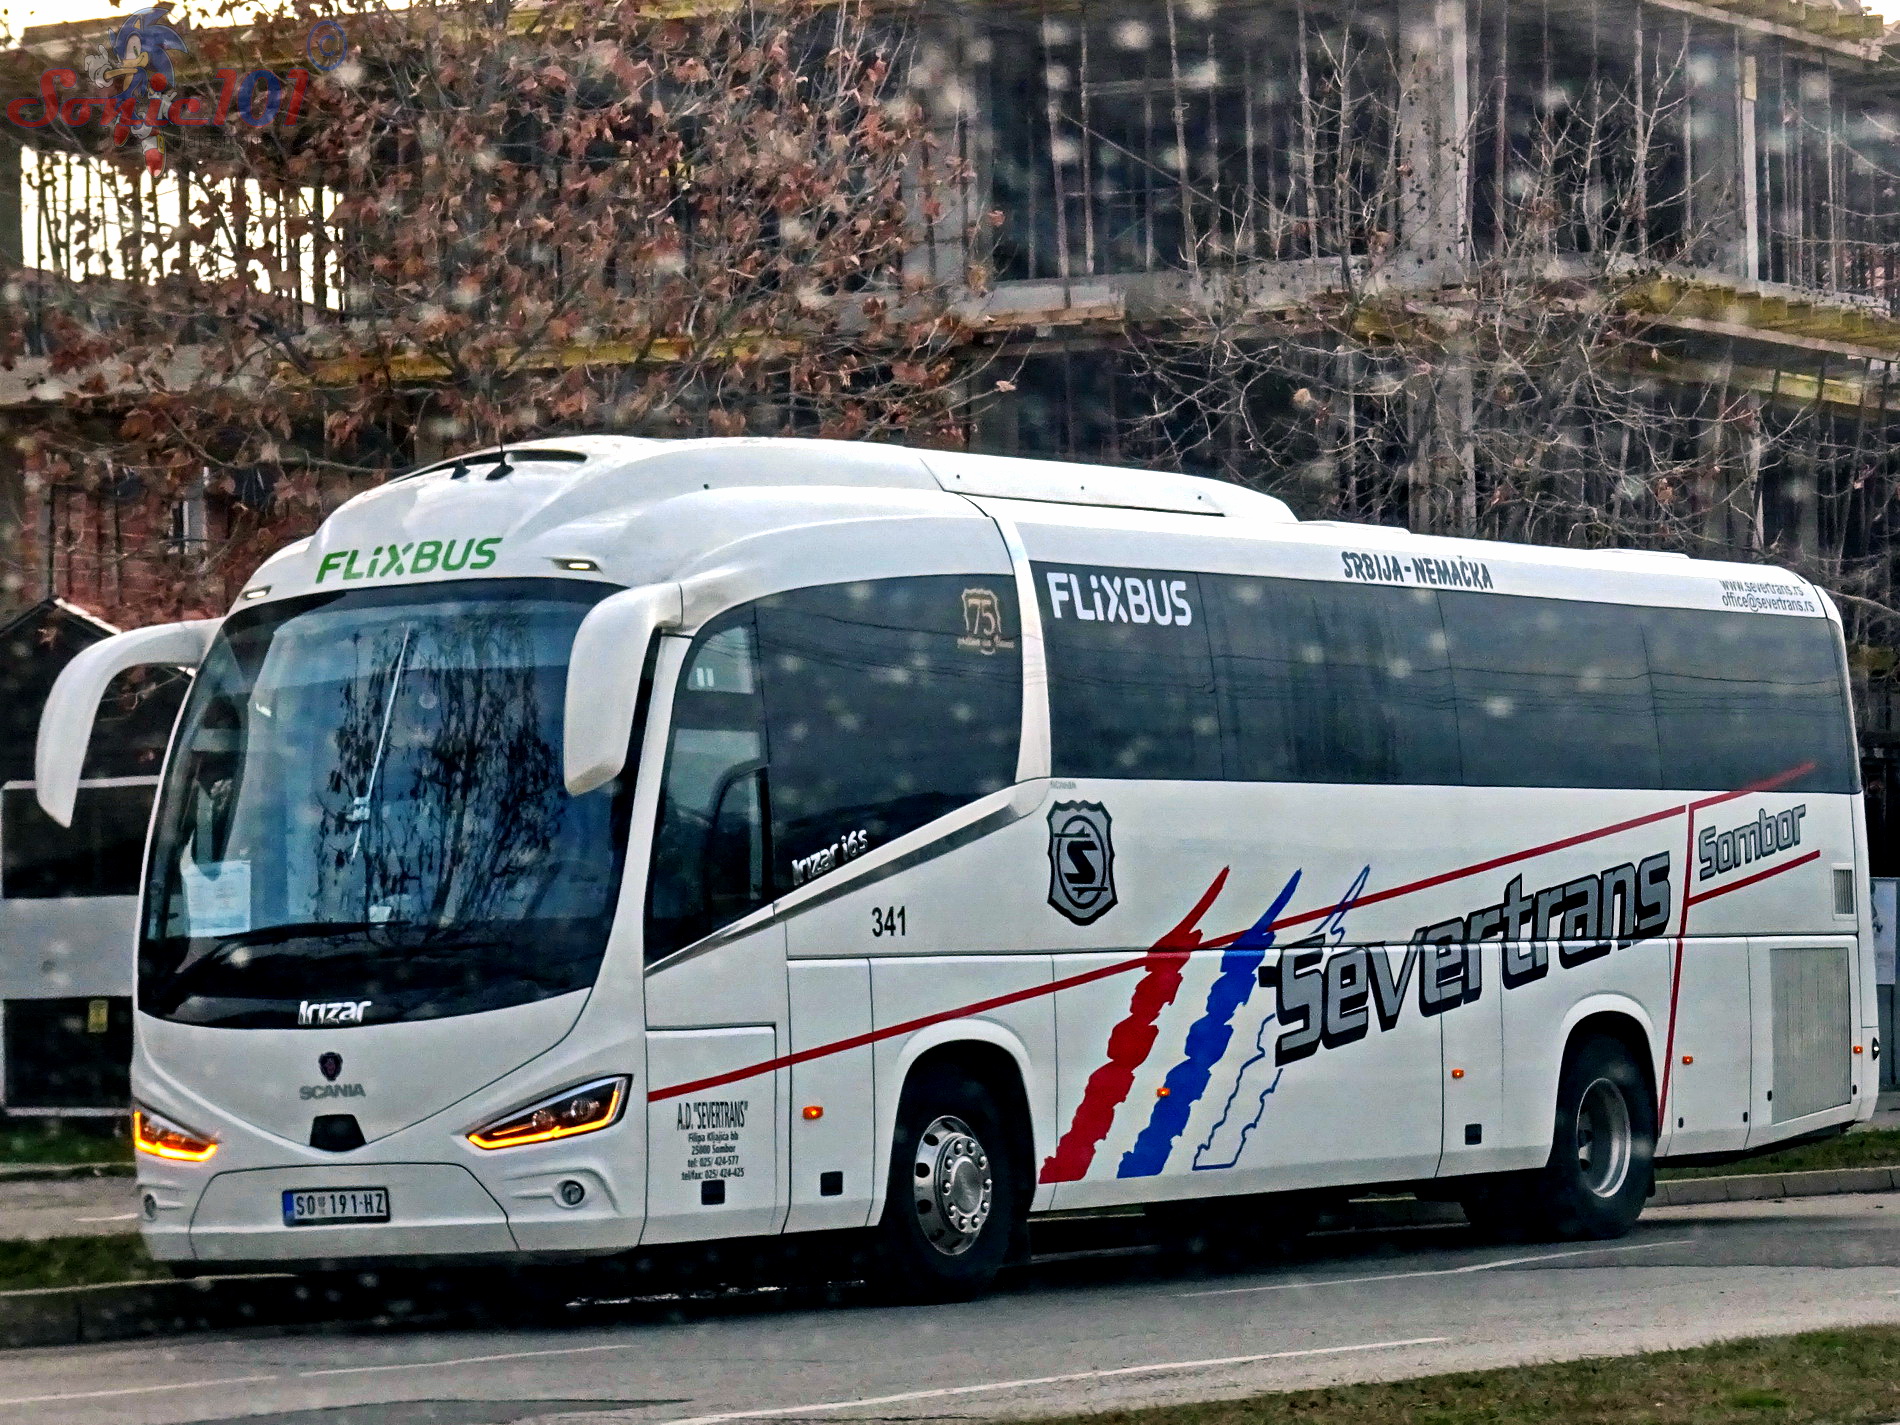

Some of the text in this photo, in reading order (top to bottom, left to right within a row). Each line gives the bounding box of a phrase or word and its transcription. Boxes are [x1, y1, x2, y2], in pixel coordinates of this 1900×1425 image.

[1720, 579, 1804, 597] www.severtrans.rs
[1721, 590, 1815, 612] office@severtrans.rs
[1698, 803, 1806, 882] Sombor
[791, 843, 839, 886] Irizar
[872, 905, 906, 937] 341
[1259, 850, 1671, 1067] Severtrans
[298, 1000, 372, 1026] Irizar
[299, 1083, 367, 1100] SCANIA
[712, 1143, 736, 1154] Sombor
[296, 1194, 315, 1216] SO
